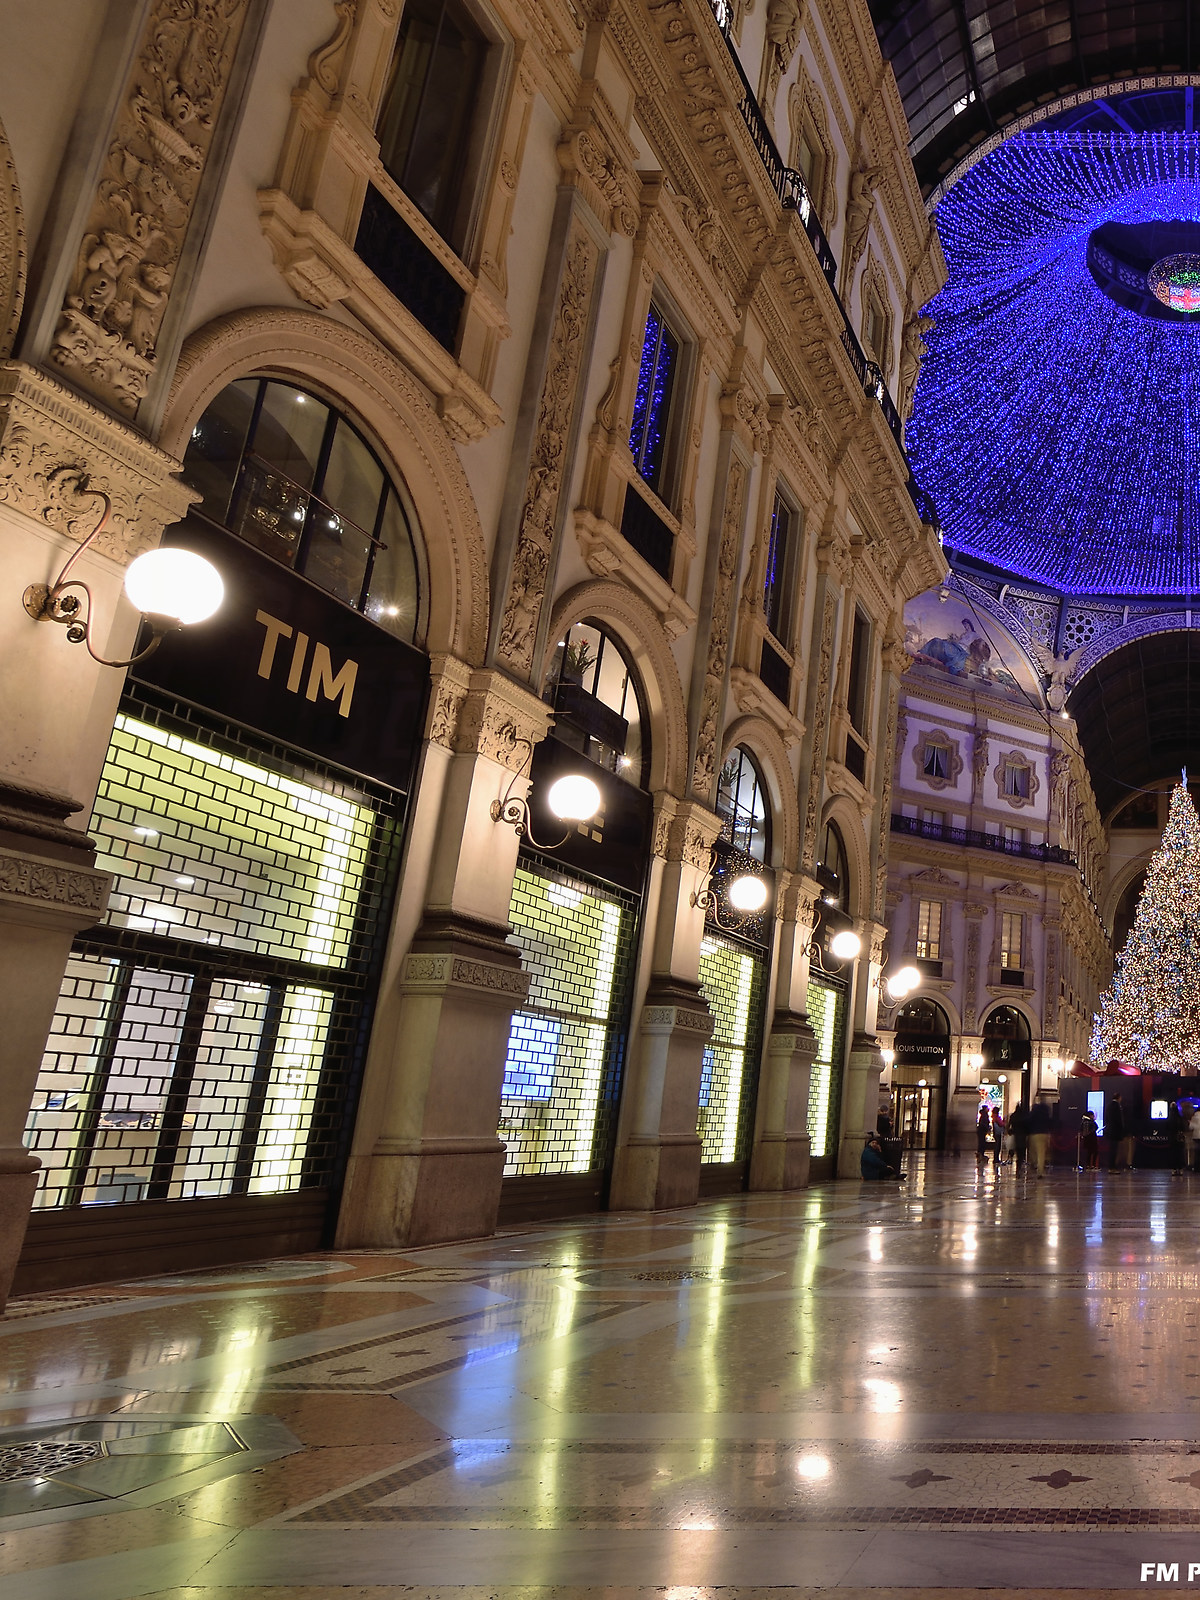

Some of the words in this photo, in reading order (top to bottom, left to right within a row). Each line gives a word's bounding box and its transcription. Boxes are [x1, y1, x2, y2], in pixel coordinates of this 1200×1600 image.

[256, 608, 359, 718] TIM
[895, 1044, 915, 1052] LOUIS
[916, 1045, 944, 1054] VUITTON
